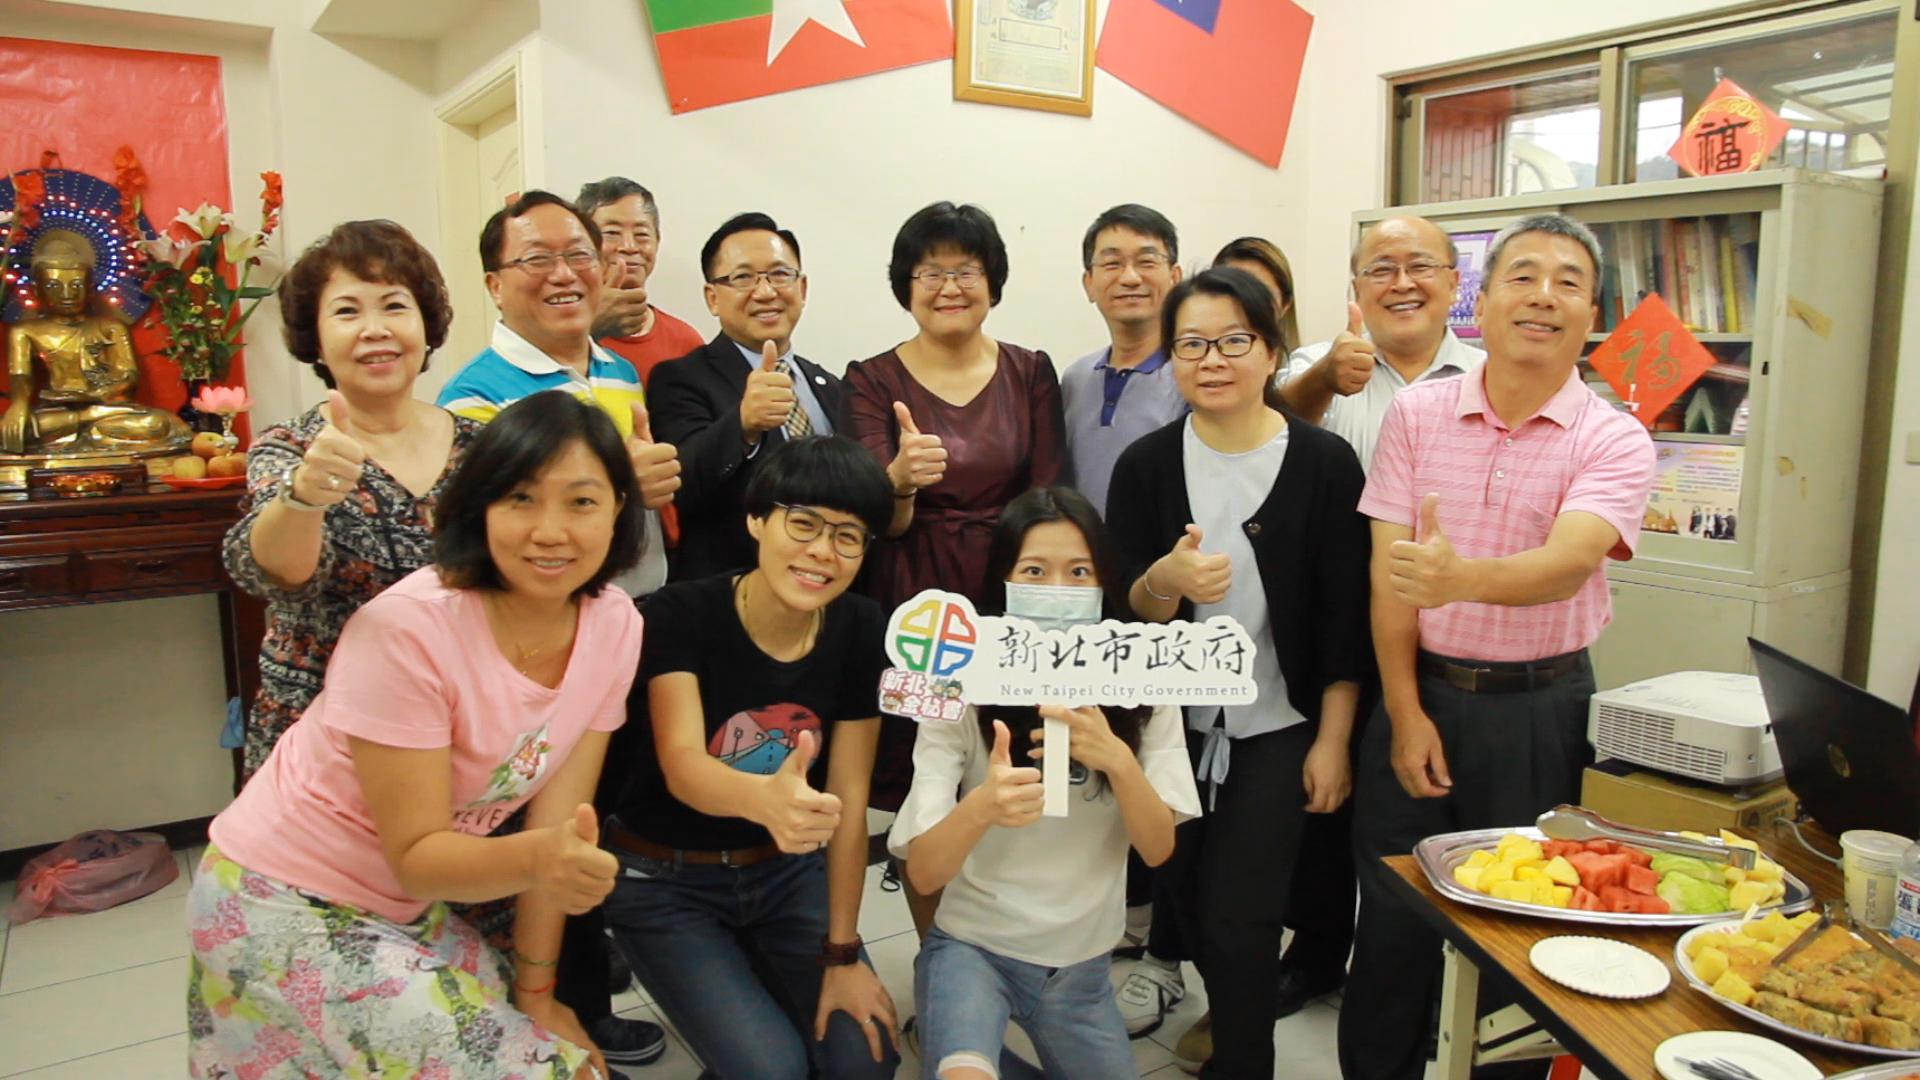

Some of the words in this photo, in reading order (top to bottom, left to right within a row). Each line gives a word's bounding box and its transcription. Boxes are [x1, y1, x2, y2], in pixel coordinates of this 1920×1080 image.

[1694, 118, 1750, 175] 福
[998, 625, 1246, 676] 新北市政府
[1000, 684, 1034, 696] New
[1041, 684, 1094, 700] Taipei
[1101, 684, 1136, 698] City
[1143, 684, 1248, 697] Government
